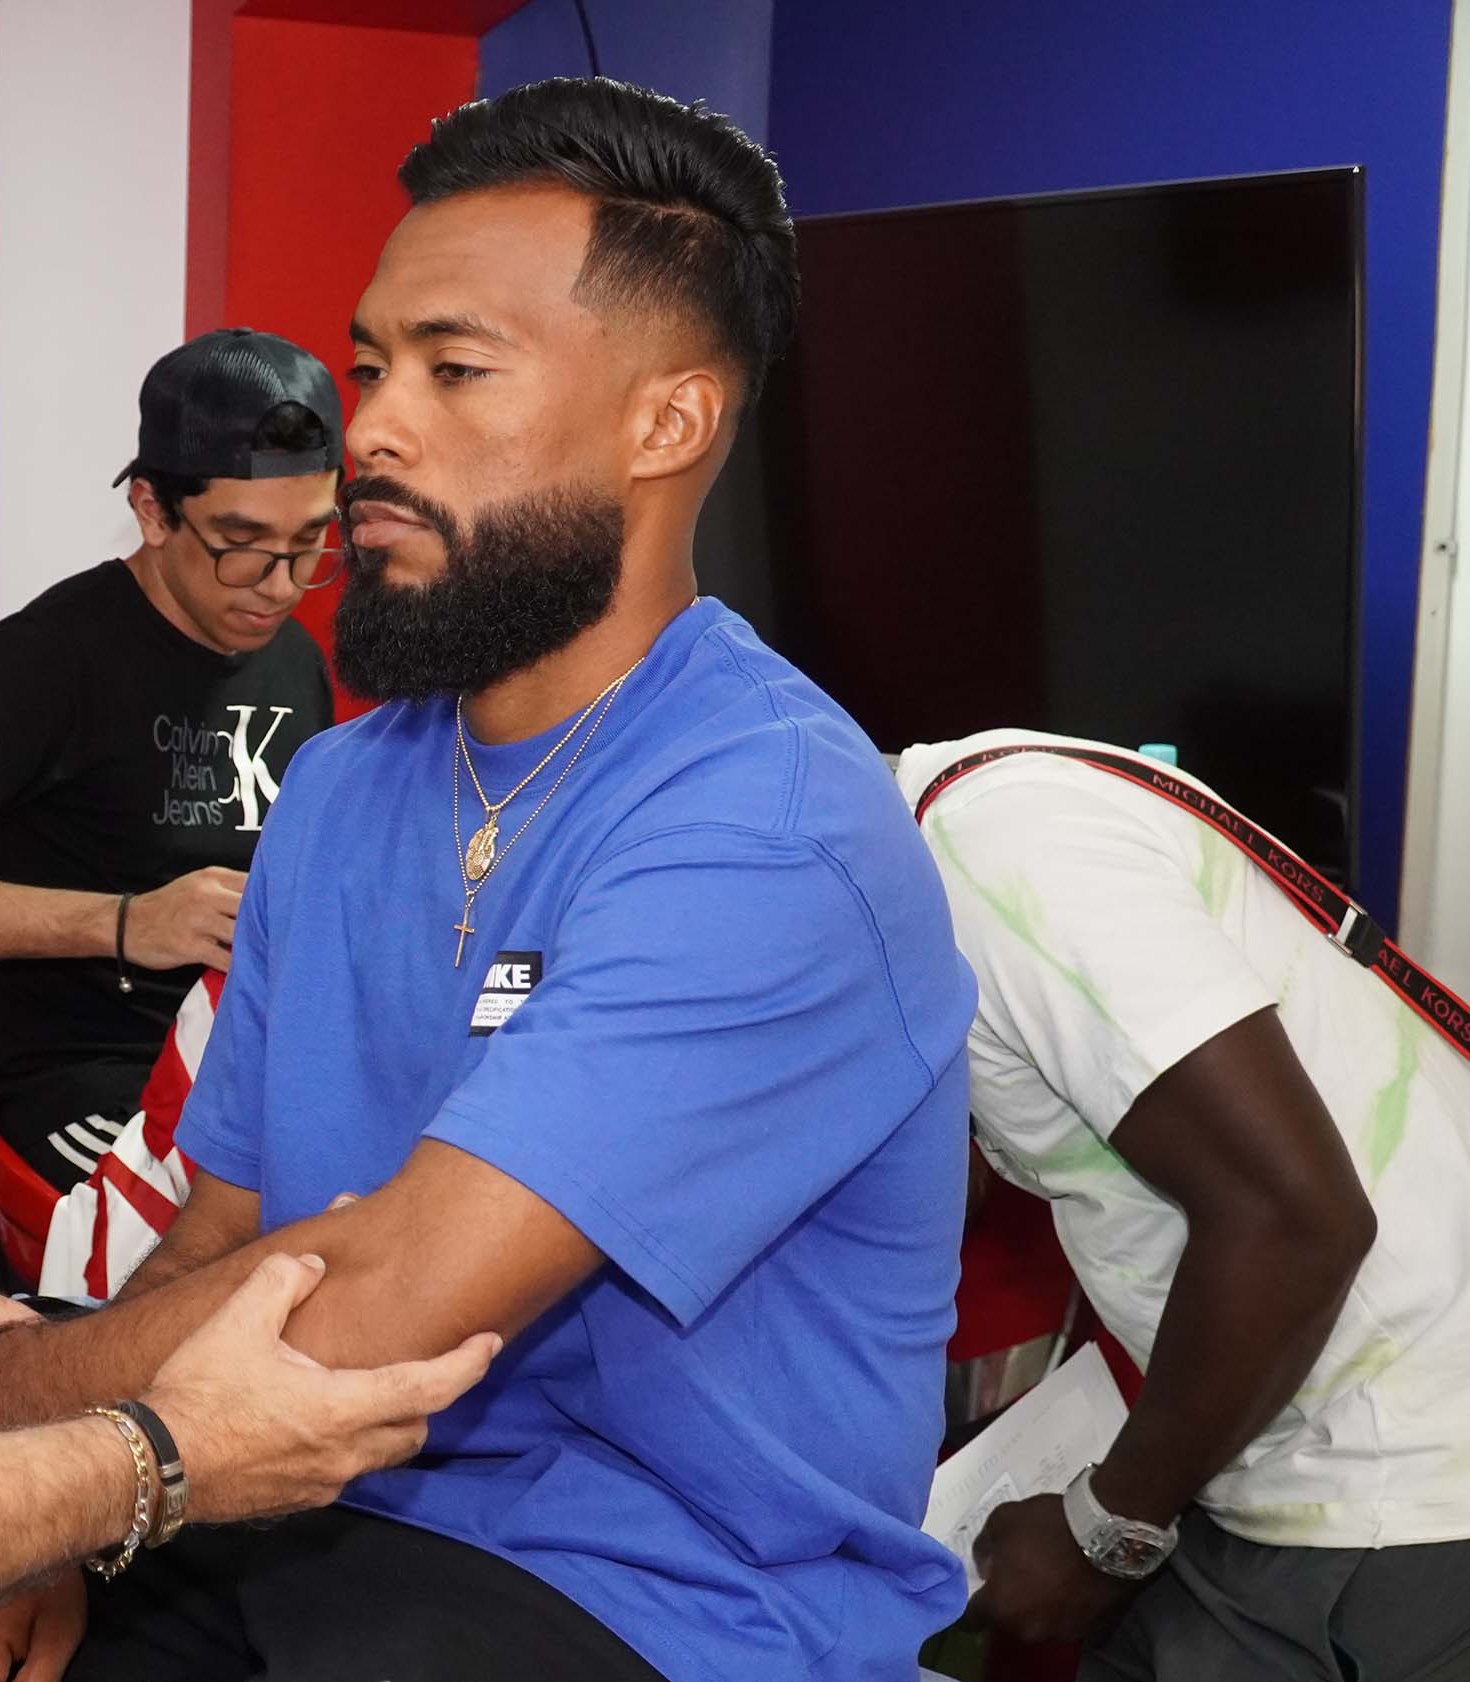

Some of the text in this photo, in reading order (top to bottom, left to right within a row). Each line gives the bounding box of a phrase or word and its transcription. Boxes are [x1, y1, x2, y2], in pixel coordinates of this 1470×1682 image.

[153, 714, 219, 756] Calvin
[171, 753, 217, 791] Klein
[152, 789, 224, 826] Jeans
[1267, 848, 1326, 902] KORS
